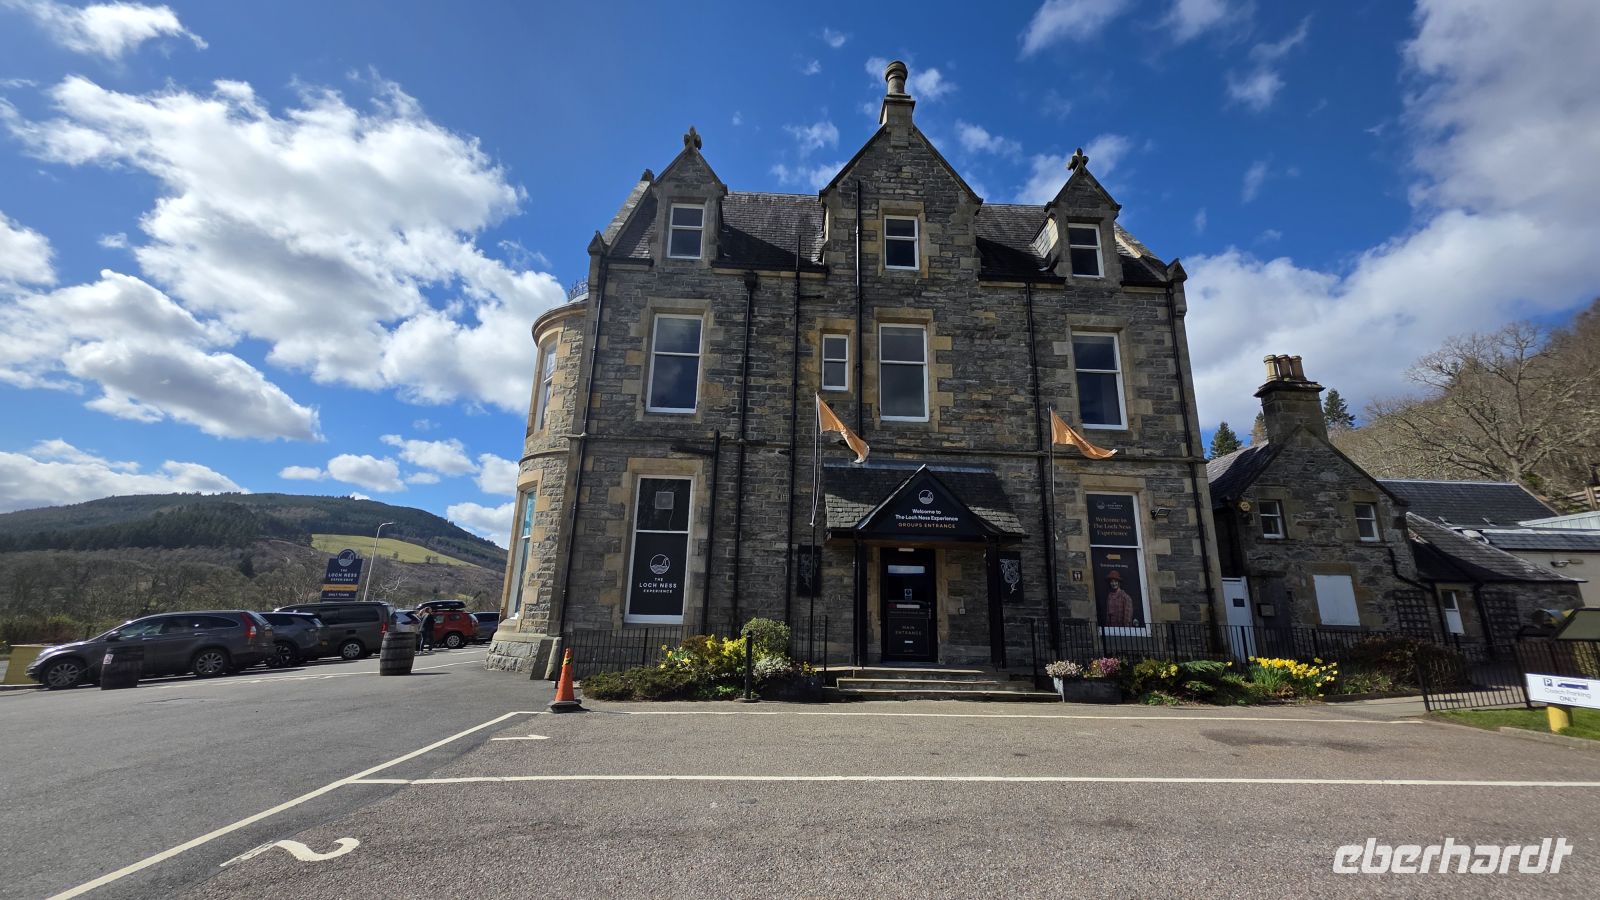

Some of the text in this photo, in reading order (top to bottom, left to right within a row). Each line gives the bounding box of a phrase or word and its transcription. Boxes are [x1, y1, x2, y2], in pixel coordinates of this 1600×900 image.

[1544, 687, 1592, 699] Coach Parking
[1559, 695, 1577, 703] ONLY
[219, 837, 360, 867] 2
